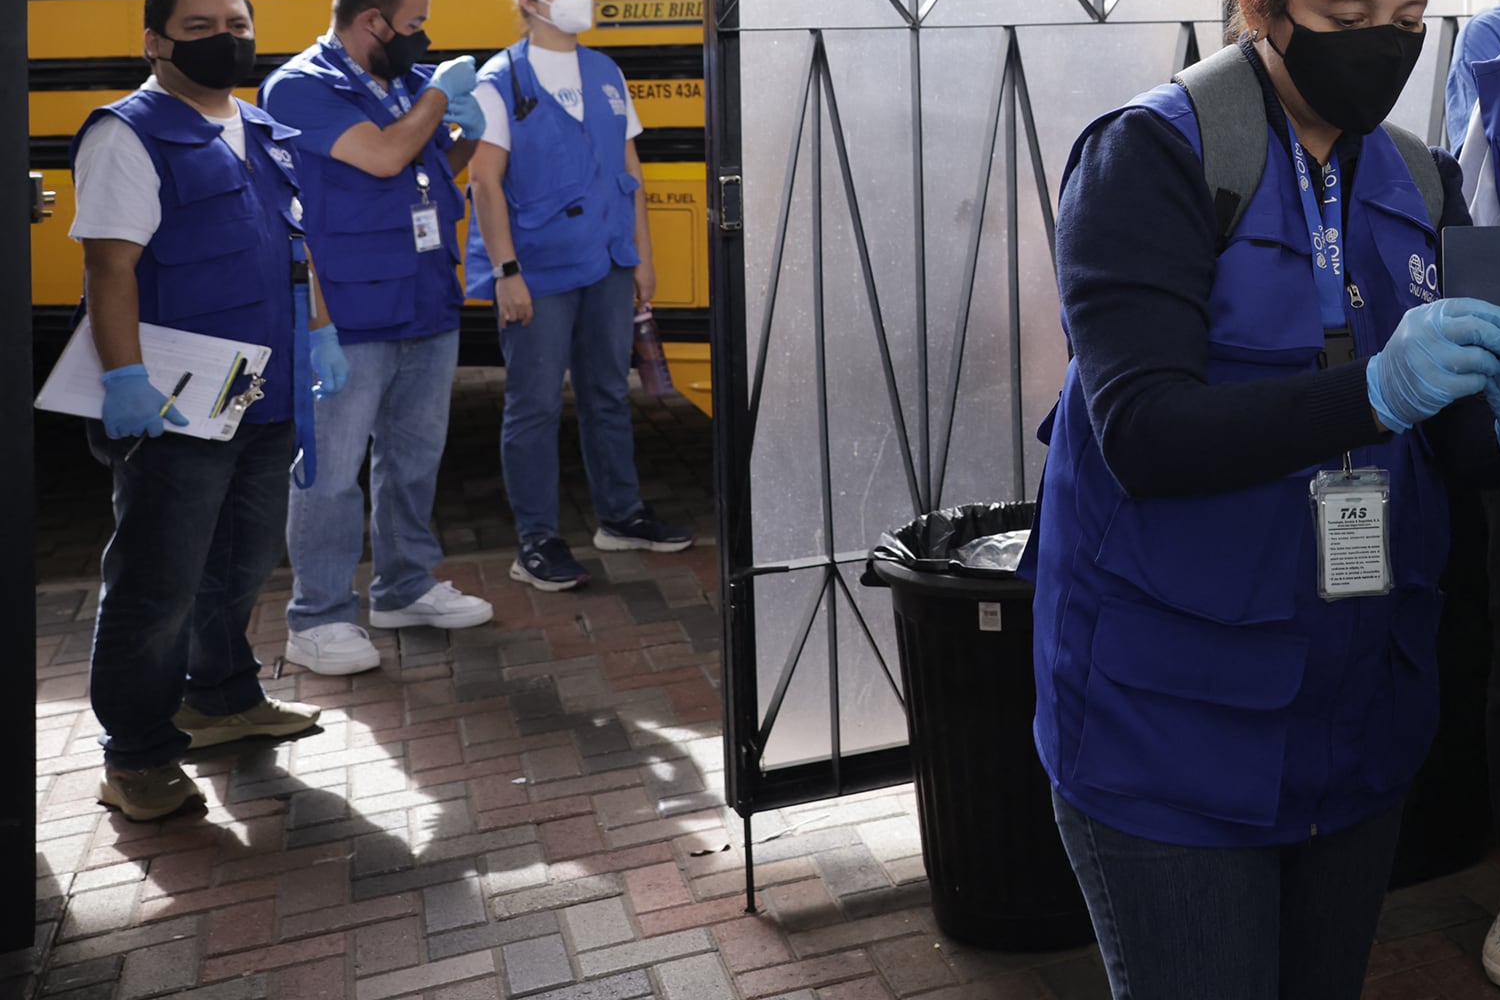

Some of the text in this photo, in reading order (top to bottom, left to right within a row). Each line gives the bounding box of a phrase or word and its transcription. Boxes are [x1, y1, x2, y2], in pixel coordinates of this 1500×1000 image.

[622, 3, 664, 19] BLUE
[628, 83, 702, 100] SEATS 43A
[646, 192, 696, 204] SEL FUEL
[1312, 231, 1323, 250] OI
[1341, 507, 1368, 520] TAS
